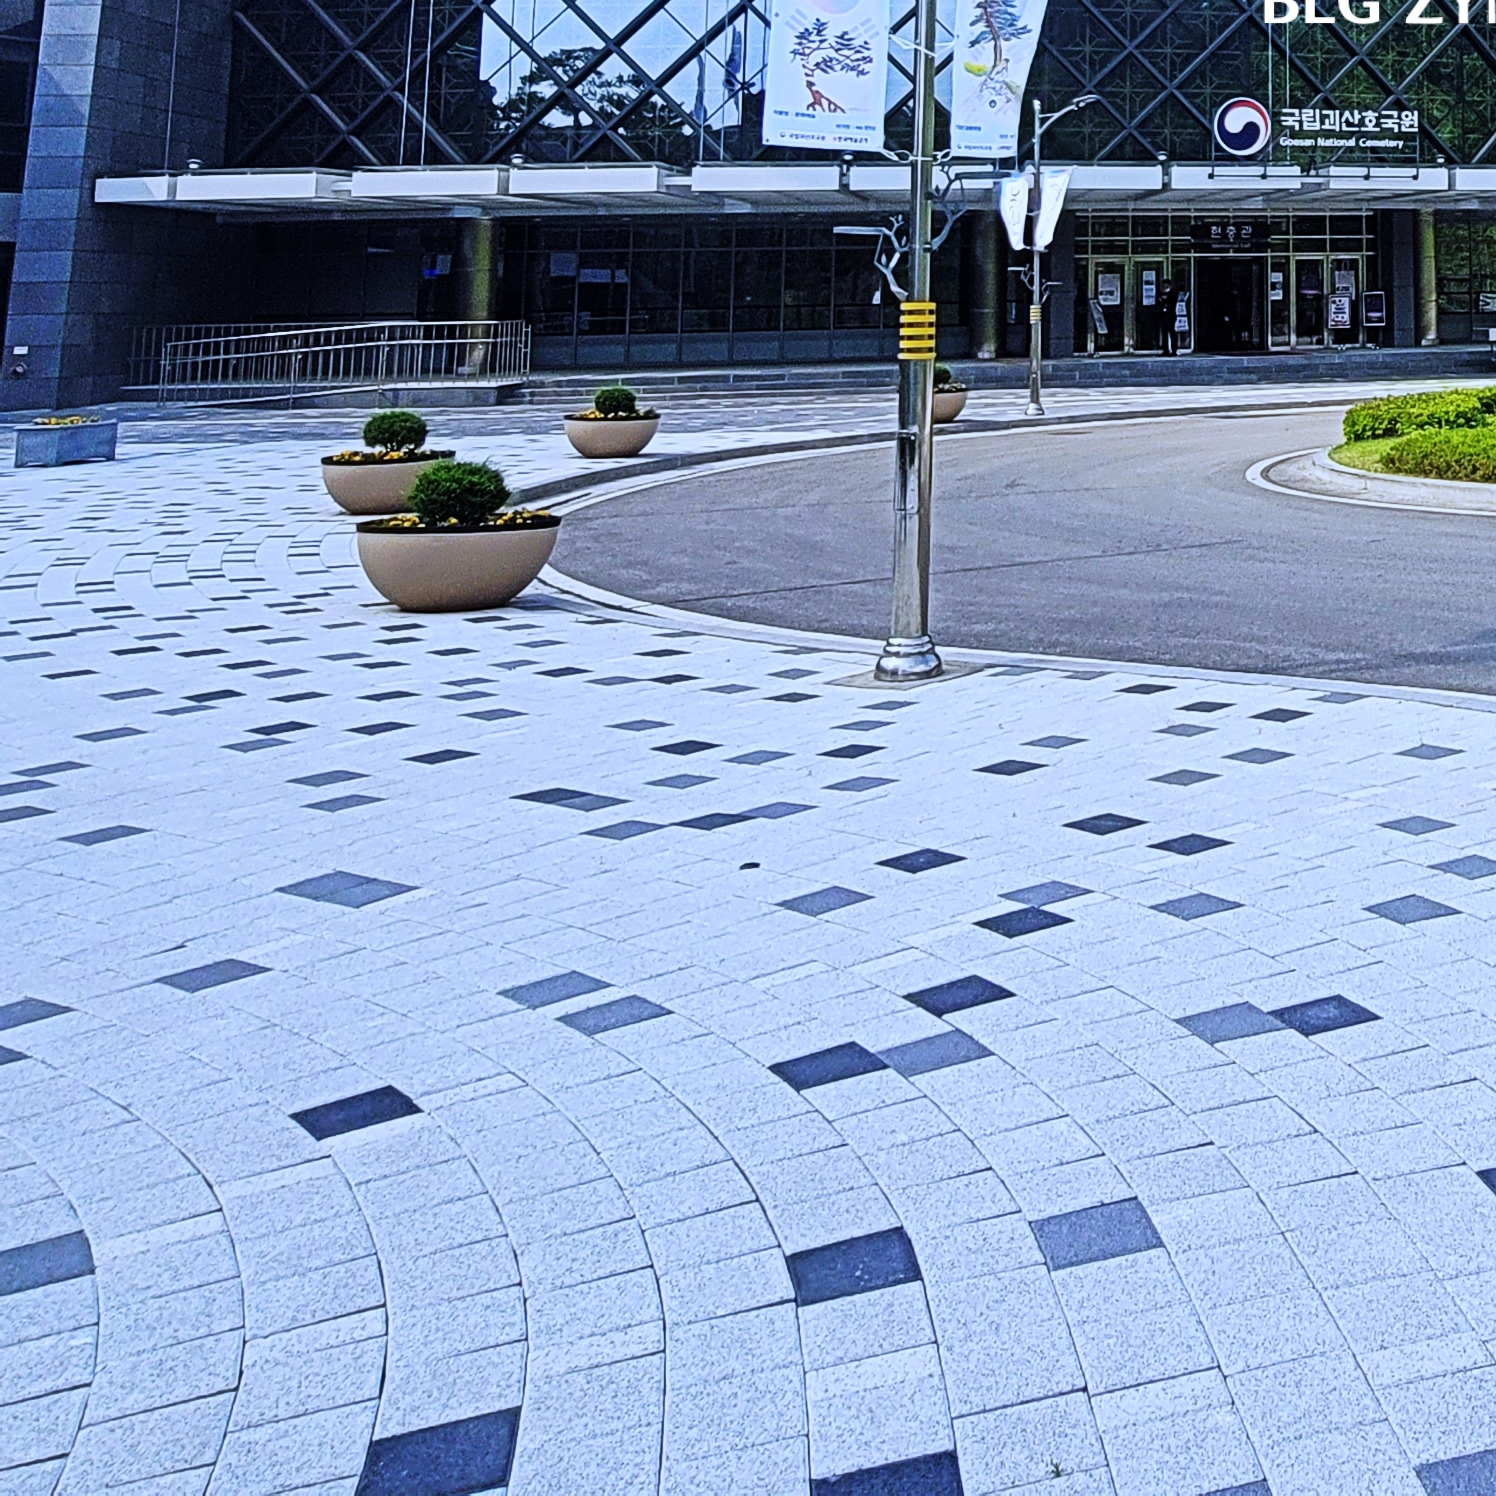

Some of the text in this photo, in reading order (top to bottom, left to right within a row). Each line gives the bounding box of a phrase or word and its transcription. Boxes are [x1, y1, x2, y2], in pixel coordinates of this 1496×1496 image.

[1280, 108, 1419, 133] 국립괴산호국원
[1279, 136, 1404, 150] Goesan National Cemetery
